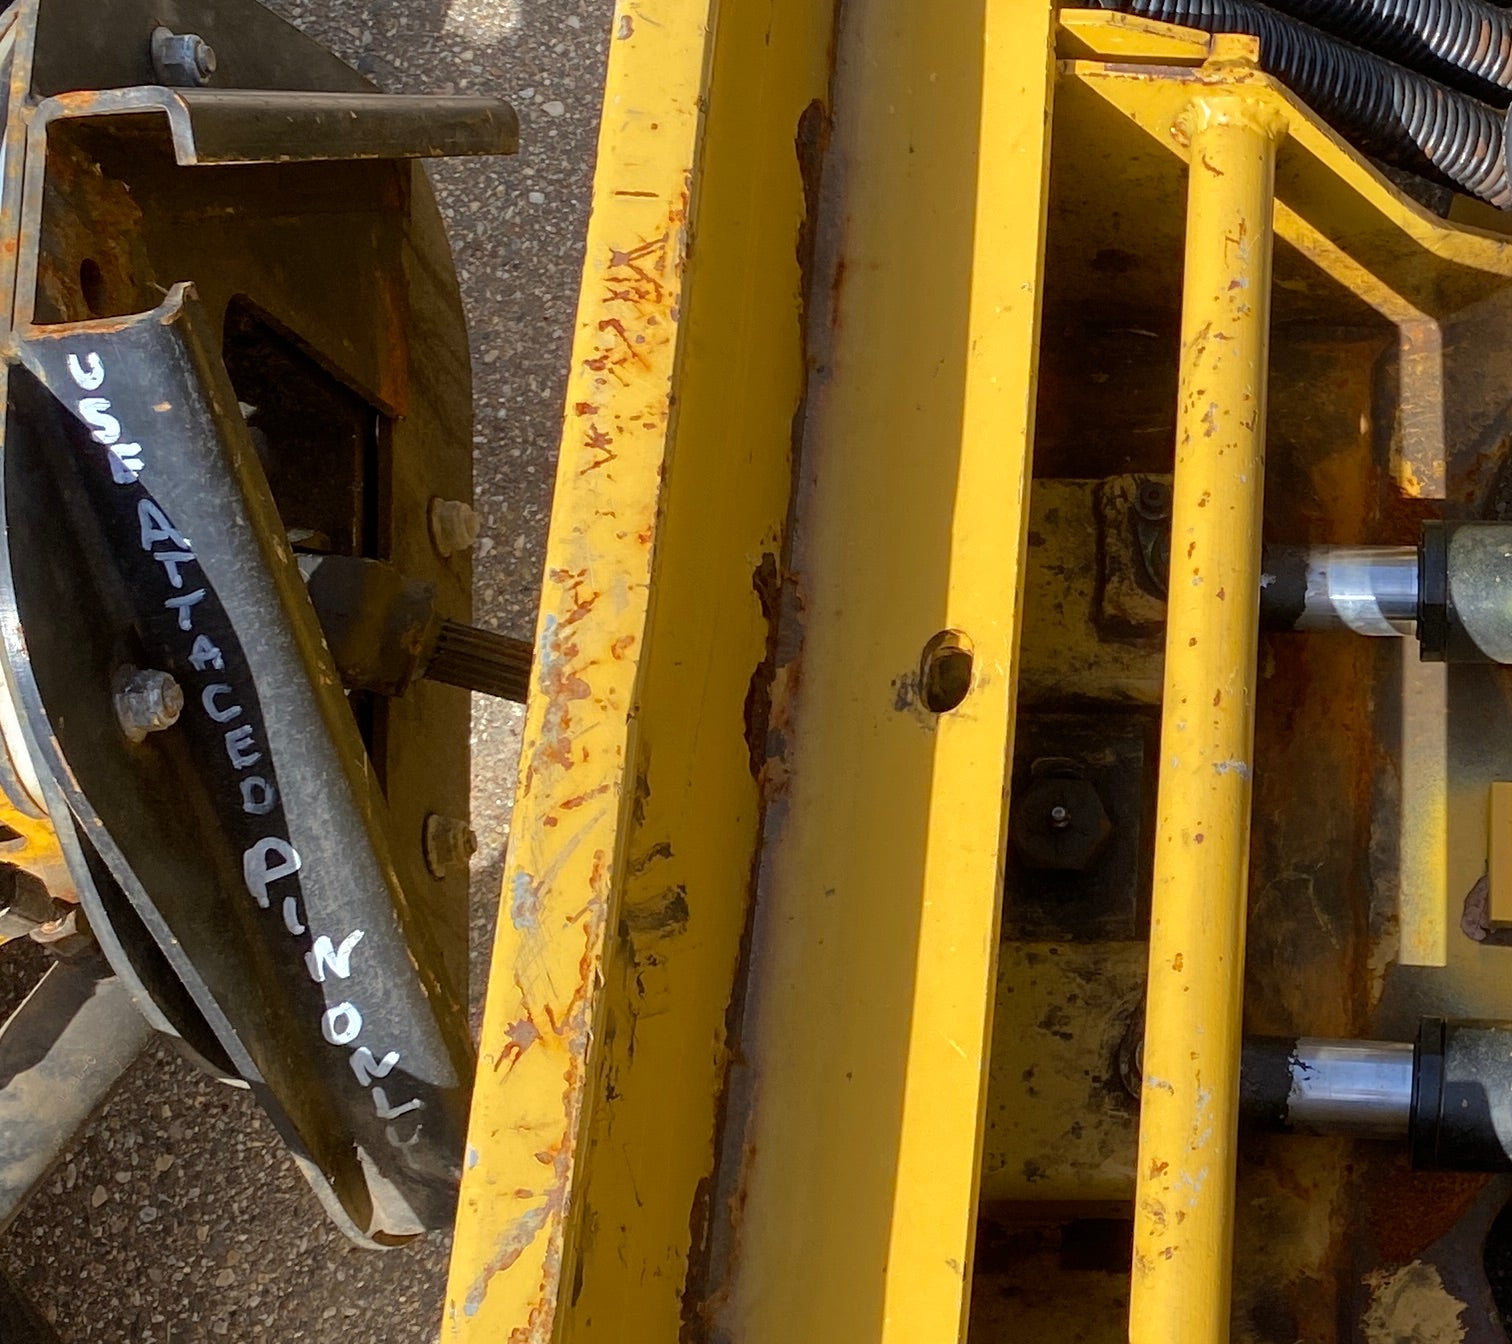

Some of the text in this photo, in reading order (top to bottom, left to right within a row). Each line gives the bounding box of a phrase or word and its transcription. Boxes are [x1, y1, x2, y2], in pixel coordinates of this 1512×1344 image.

[66, 351, 425, 1164] USE ATTACED PIN ONLY
